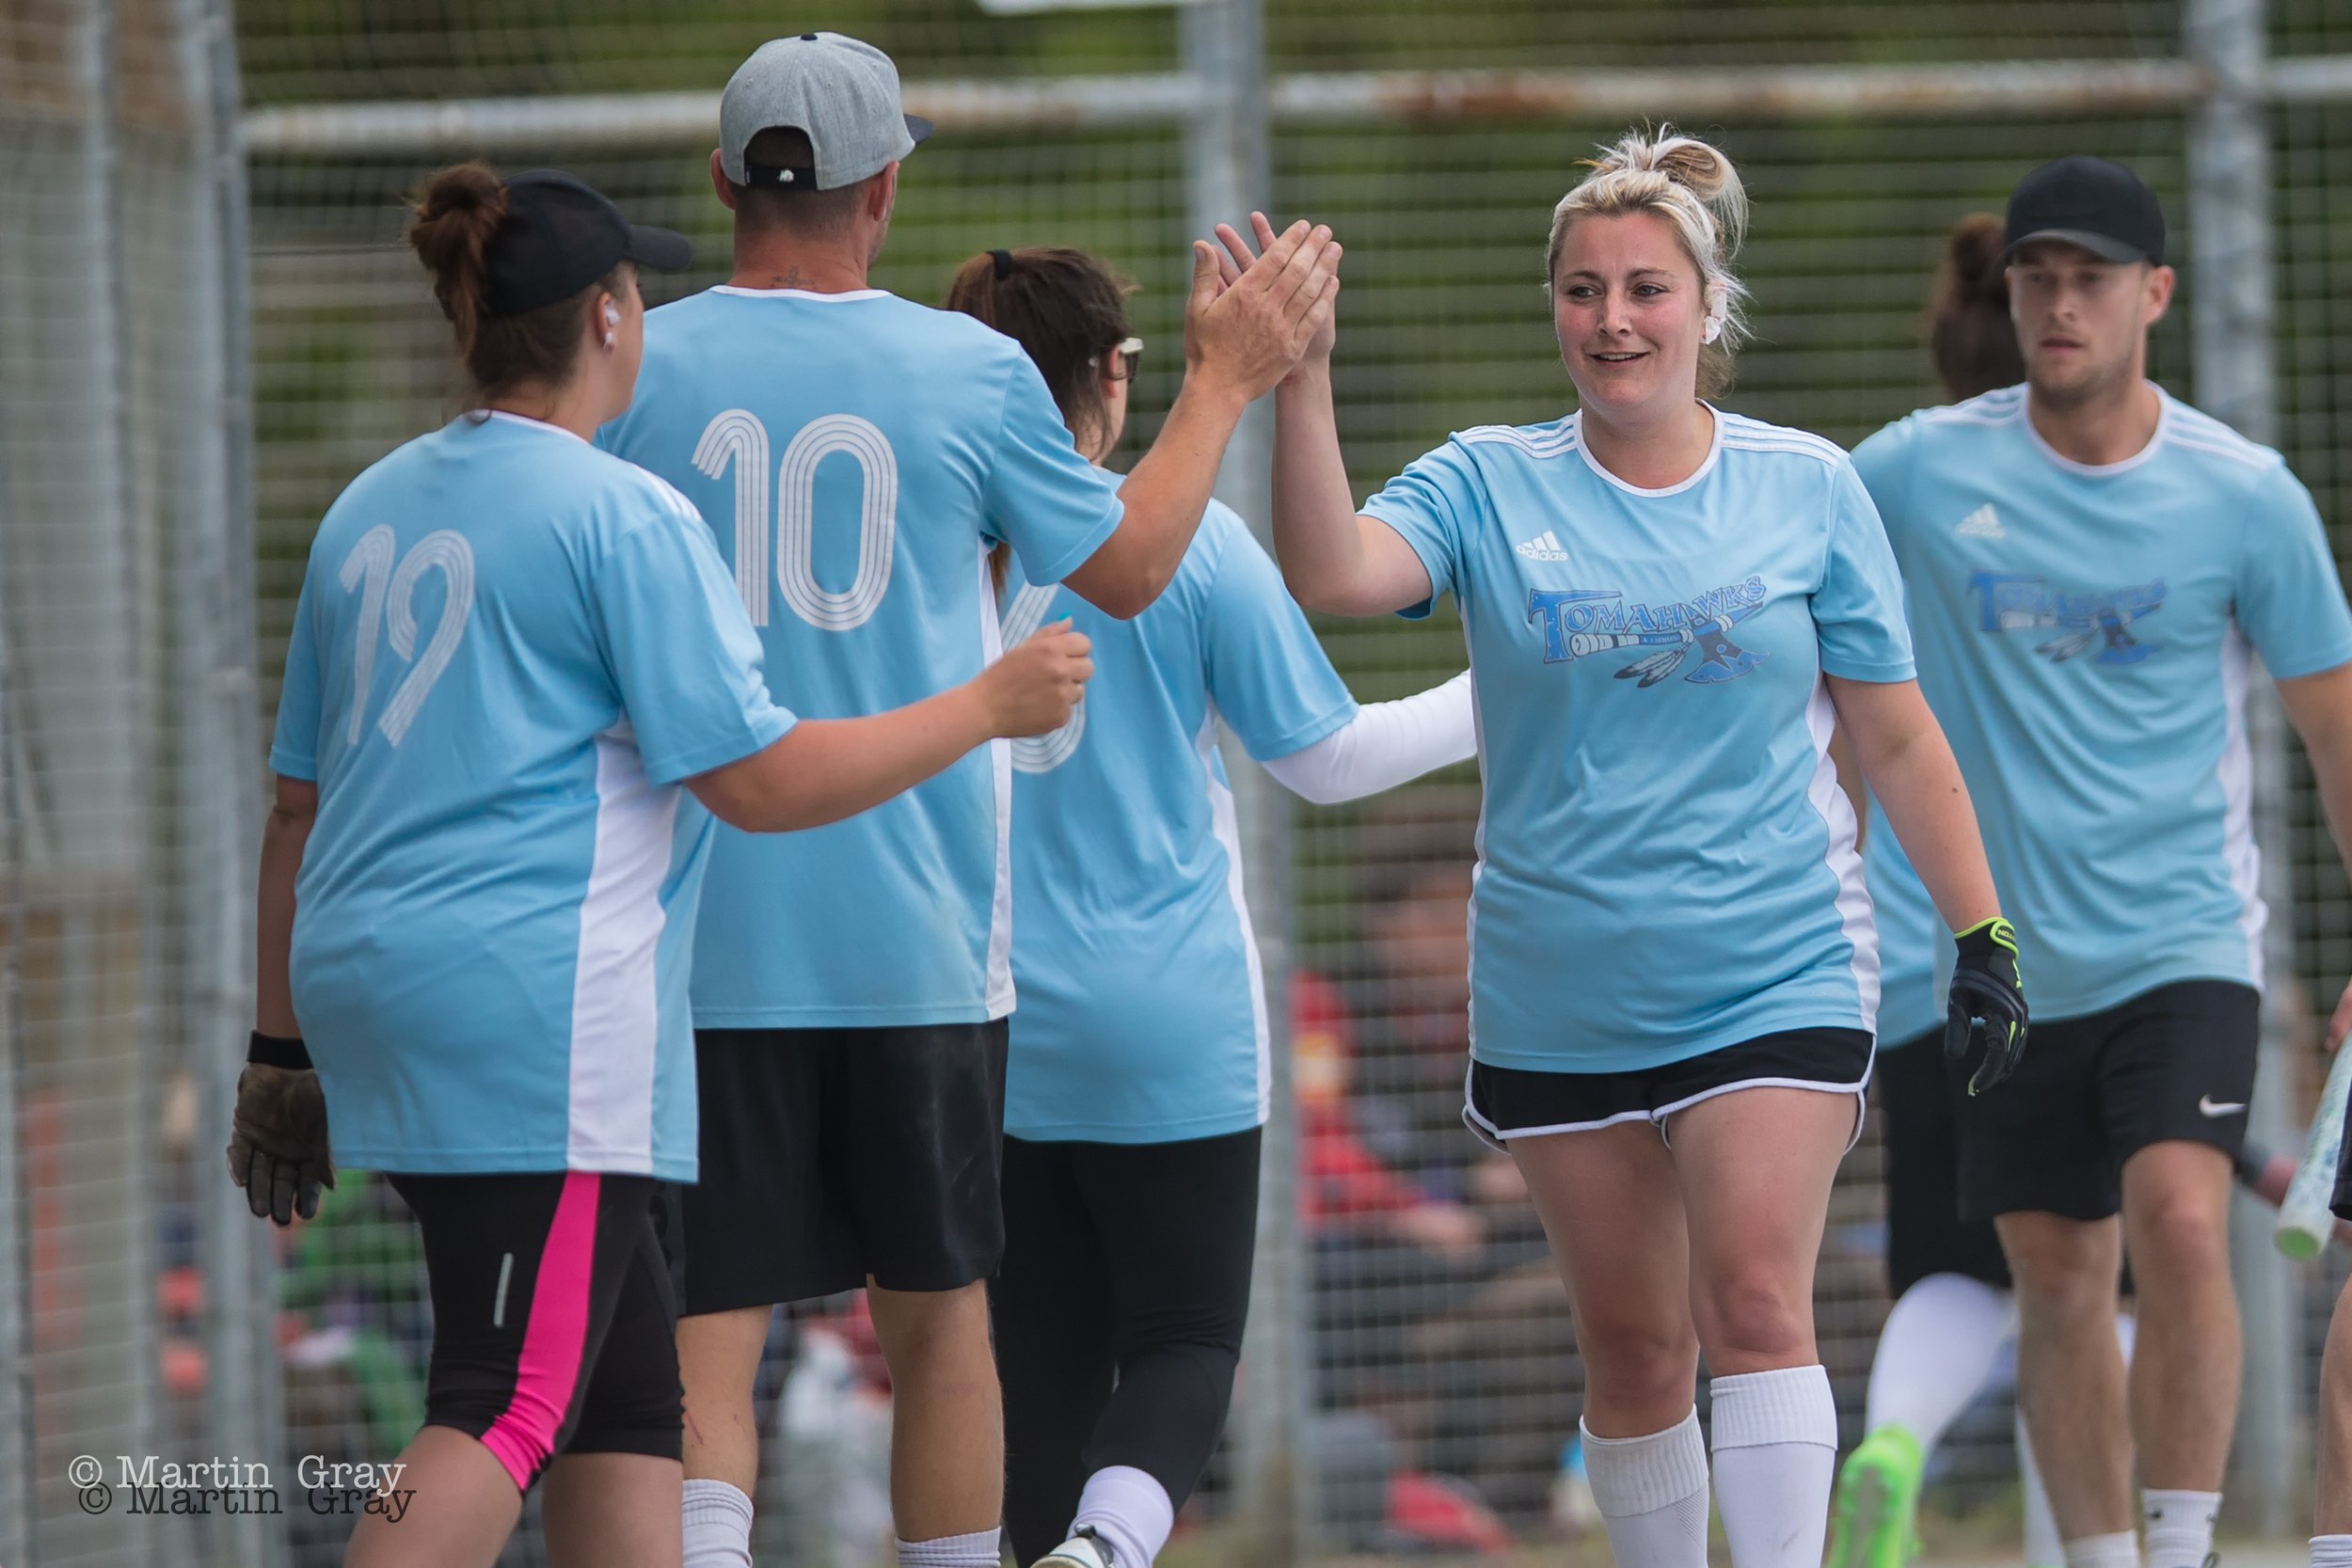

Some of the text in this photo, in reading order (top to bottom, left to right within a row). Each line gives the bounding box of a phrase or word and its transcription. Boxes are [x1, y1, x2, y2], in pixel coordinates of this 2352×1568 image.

[691, 407, 898, 632] 10
[1516, 544, 1568, 562] adidas
[339, 523, 475, 748] 19
[1528, 575, 1767, 664] TOMAHAWKS
